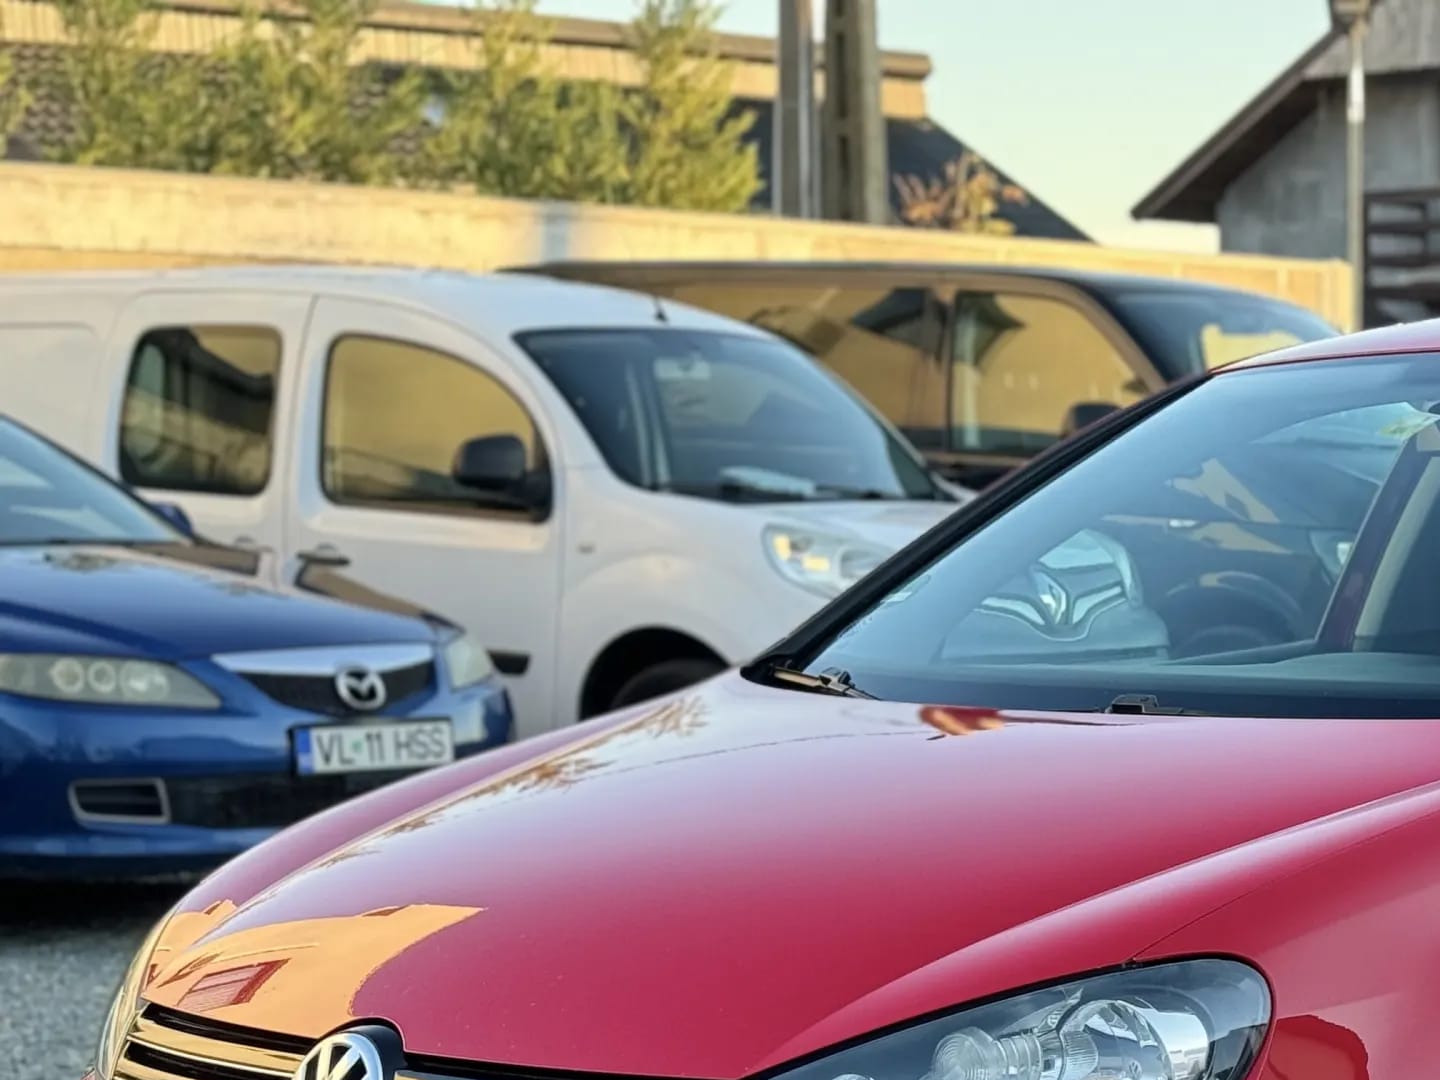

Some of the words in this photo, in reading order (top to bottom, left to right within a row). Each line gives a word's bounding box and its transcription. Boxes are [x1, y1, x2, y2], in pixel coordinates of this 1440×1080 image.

[315, 733, 354, 766] VL
[364, 730, 385, 761] 11
[394, 726, 446, 761] HSS
